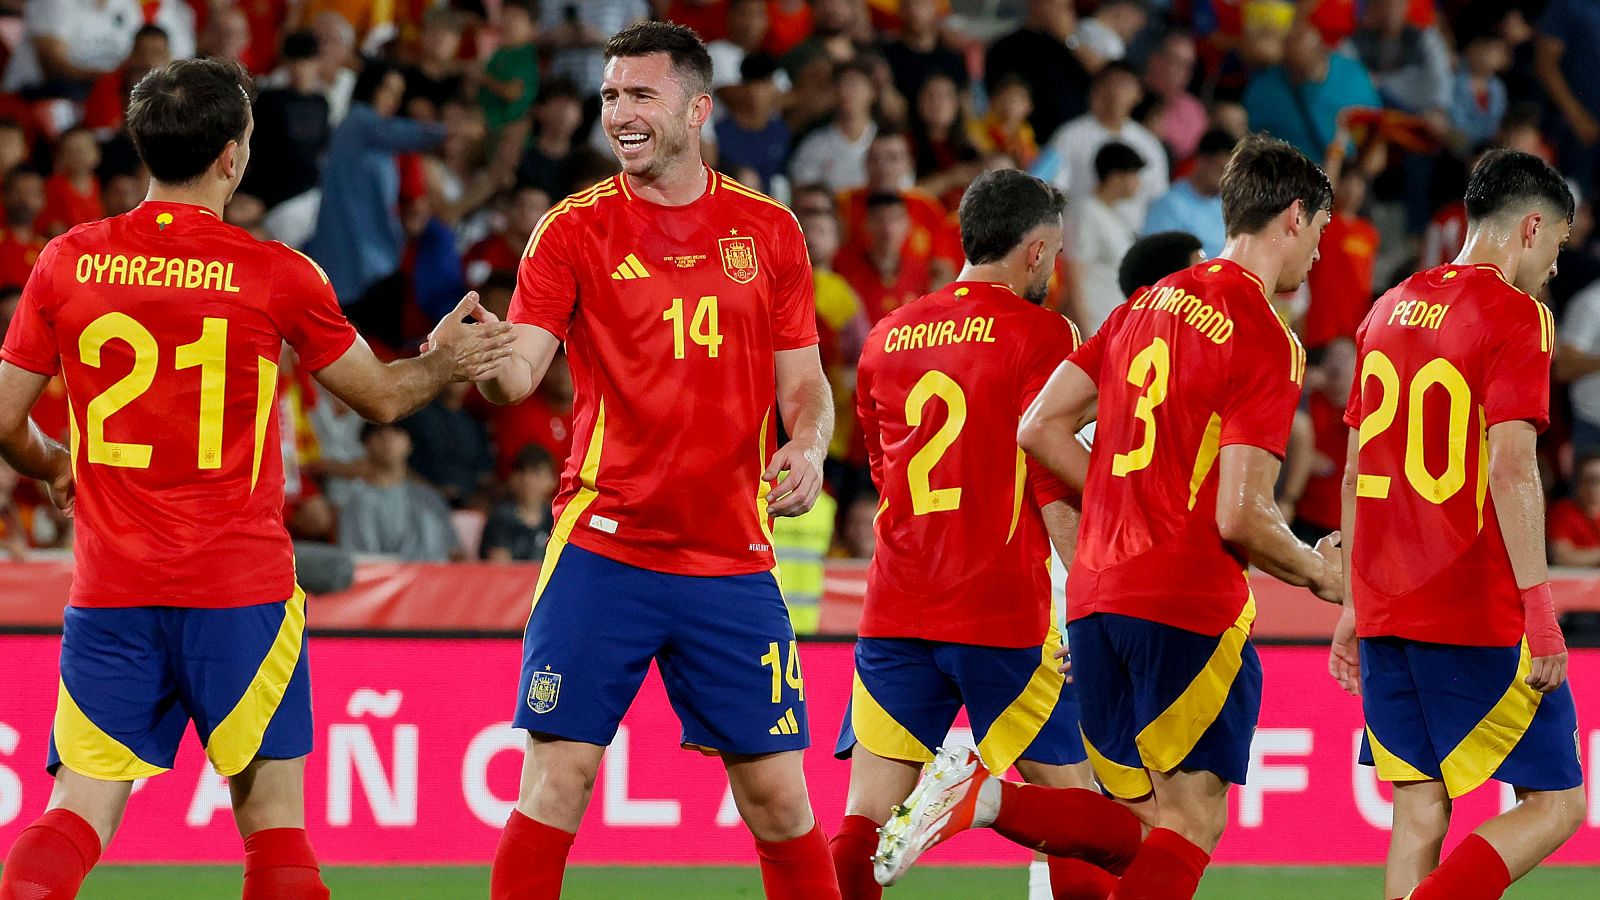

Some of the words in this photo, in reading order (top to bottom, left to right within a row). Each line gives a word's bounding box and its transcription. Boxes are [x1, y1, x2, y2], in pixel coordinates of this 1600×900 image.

[76, 253, 241, 293] OYARZABAL
[662, 295, 724, 360] 14
[884, 316, 996, 353] CARVAJAL
[1387, 299, 1449, 330] PEDRI
[78, 311, 228, 470] 21
[1111, 336, 1170, 478] 3
[904, 369, 967, 516] 2
[1356, 350, 1472, 505] 20
[760, 640, 805, 704] 14
